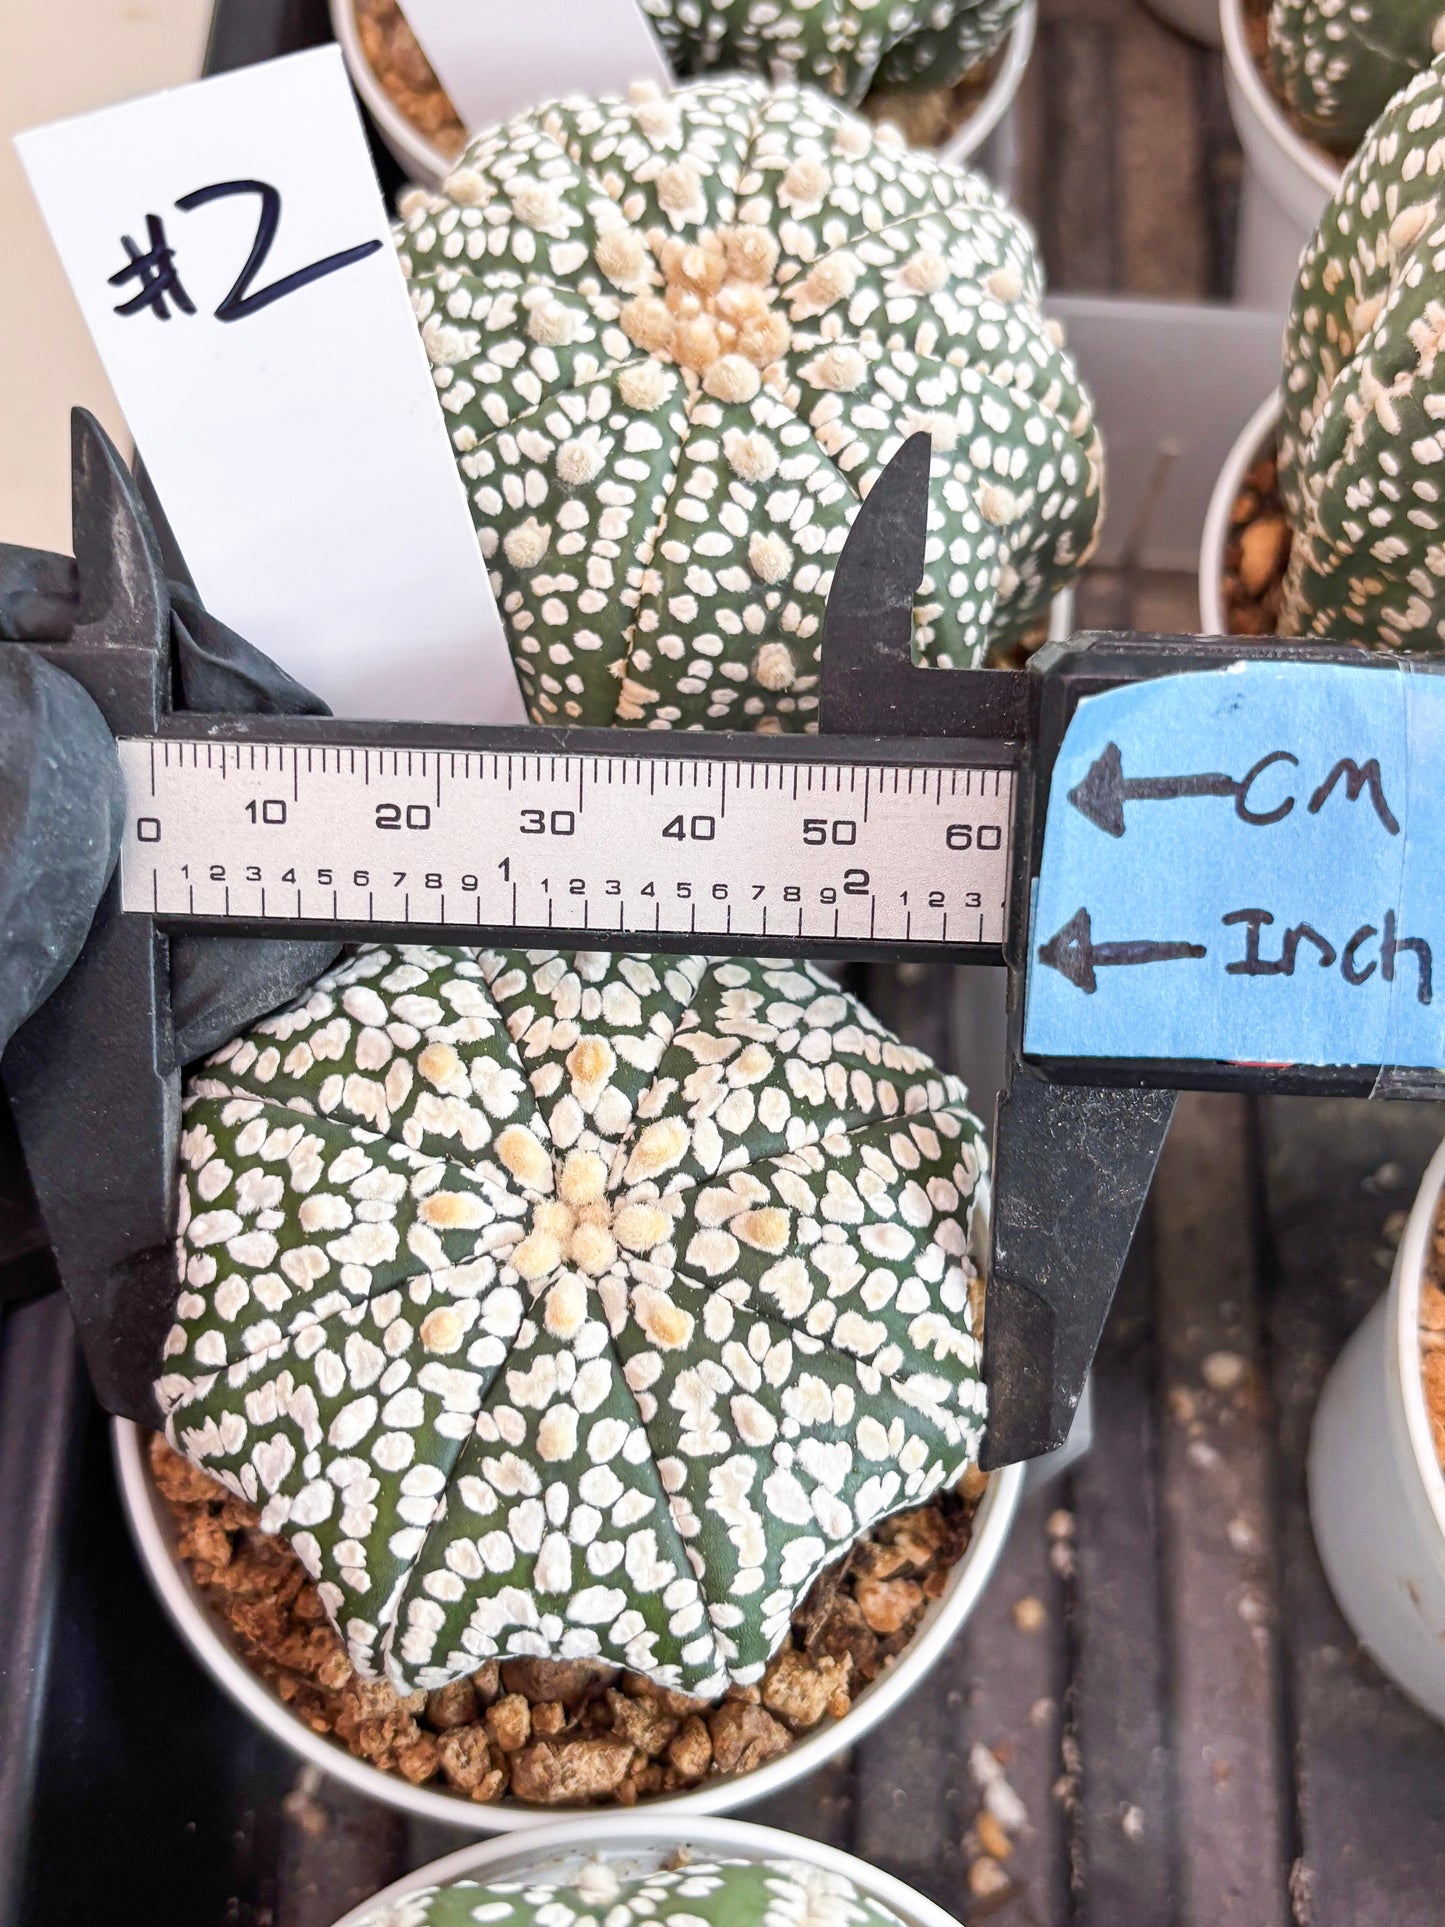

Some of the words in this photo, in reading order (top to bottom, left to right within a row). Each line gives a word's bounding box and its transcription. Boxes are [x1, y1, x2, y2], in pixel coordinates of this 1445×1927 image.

[107, 179, 384, 323] #2
[136, 816, 162, 843] 0
[244, 798, 288, 826] 10
[374, 802, 432, 831] 20
[518, 808, 577, 837] 30
[660, 814, 717, 843] 40
[801, 817, 858, 847] 50
[944, 822, 1002, 852] 60
[180, 864, 190, 881] 1
[208, 864, 227, 882] 2
[245, 865, 263, 883] 3
[280, 867, 297, 886] 4
[316, 868, 334, 887] 5
[352, 869, 371, 888] 6
[391, 871, 407, 889] 7
[424, 872, 444, 891] 8
[460, 873, 480, 892] 9
[497, 856, 511, 883] 1
[540, 877, 550, 894] 1
[567, 878, 587, 896] 2
[604, 879, 622, 897] 3
[639, 880, 656, 899] 4
[675, 881, 693, 900] 5
[711, 883, 730, 901] 6
[750, 884, 767, 902] 7
[782, 885, 802, 904] 8
[818, 886, 838, 905] 9
[842, 867, 871, 897] 2
[898, 889, 909, 907] 1
[927, 890, 947, 909] 2
[963, 891, 983, 909] 3
[1222, 907, 1433, 1005] Inch
